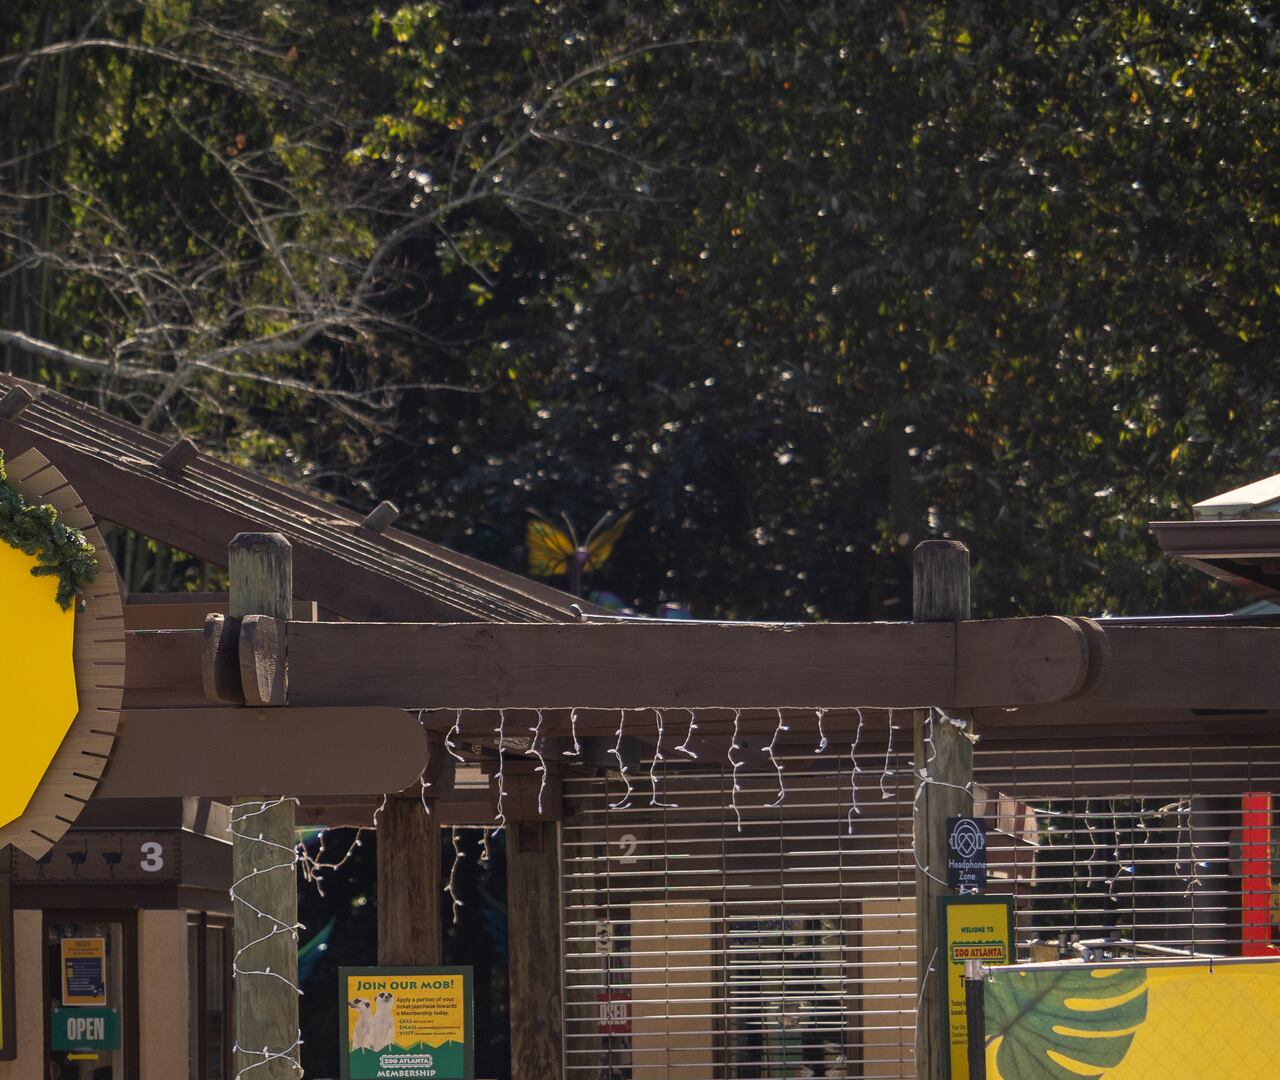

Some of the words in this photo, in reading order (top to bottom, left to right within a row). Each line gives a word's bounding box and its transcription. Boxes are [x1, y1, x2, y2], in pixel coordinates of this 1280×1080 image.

[619, 834, 637, 864] 2
[140, 842, 164, 872] 3
[948, 860, 986, 872] Headphone
[958, 871, 976, 881] Zone
[954, 949, 968, 957] ZOO
[971, 948, 1002, 957] ATLANTA
[357, 980, 386, 990] JOIN
[390, 982, 417, 990] OUR
[421, 980, 454, 990] MOB!
[66, 1017, 104, 1040] OPEN
